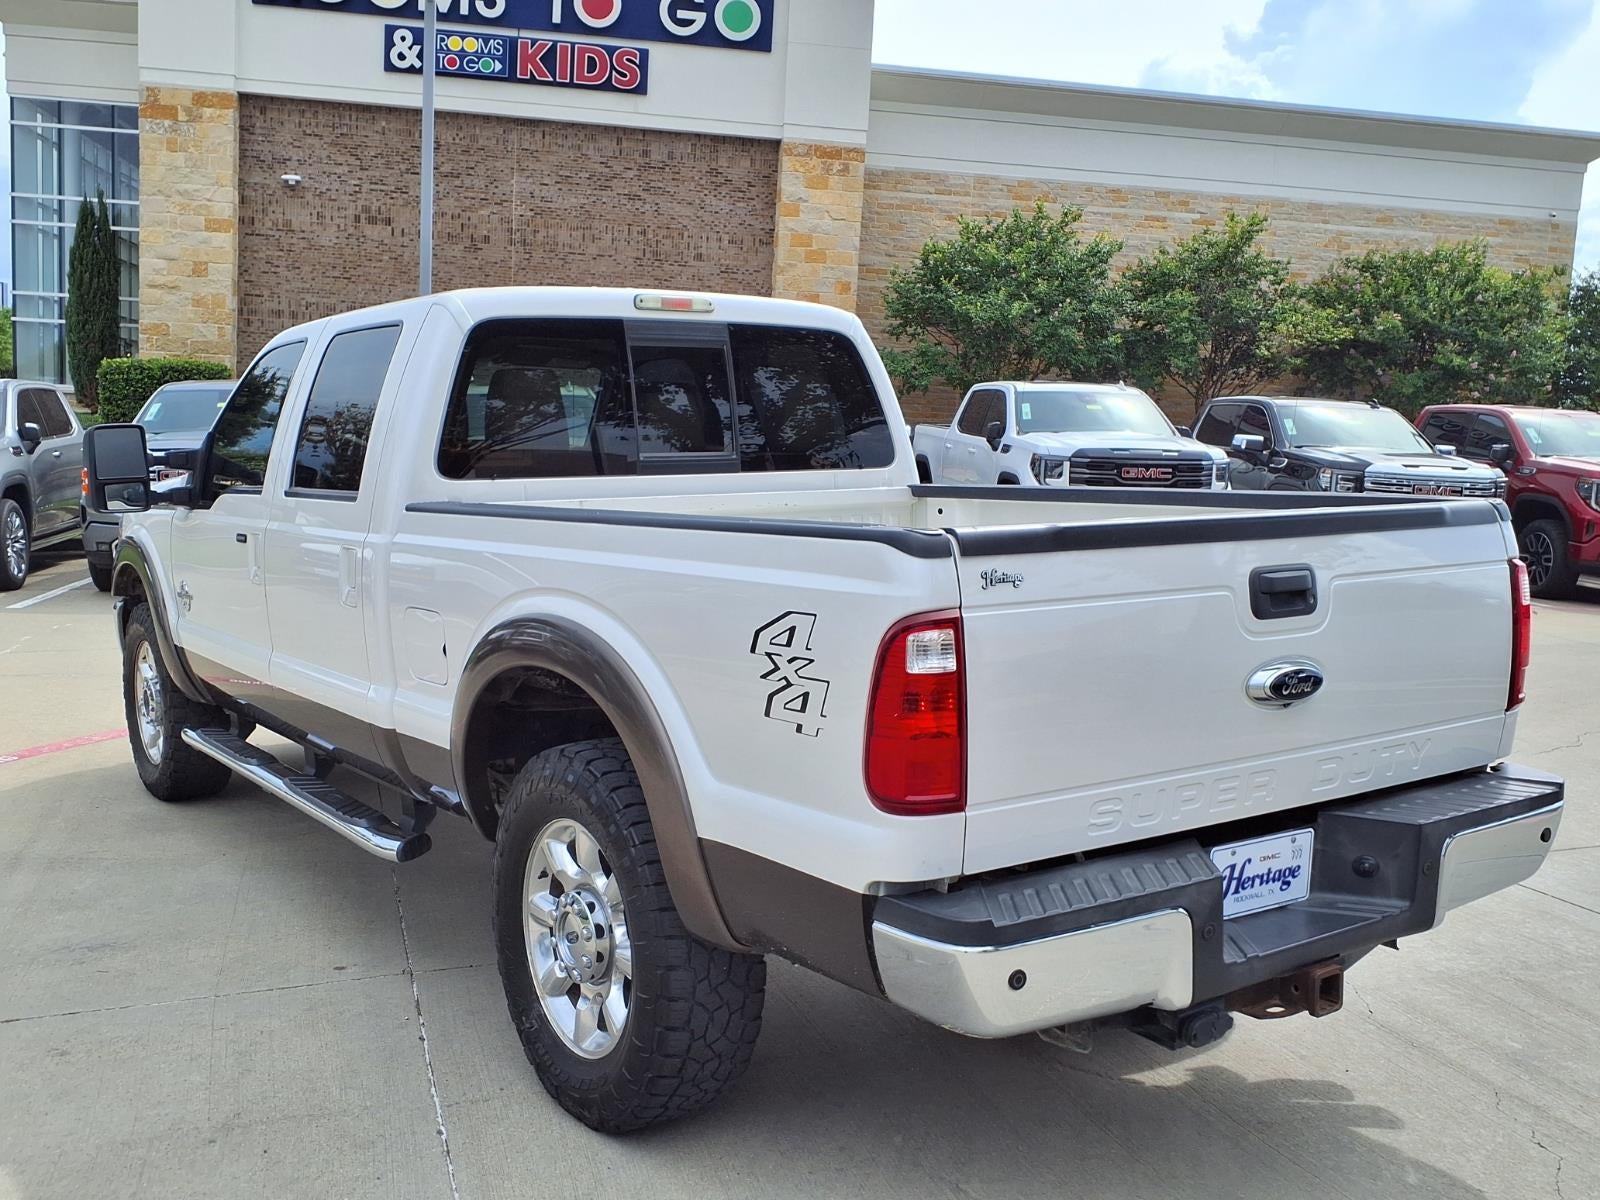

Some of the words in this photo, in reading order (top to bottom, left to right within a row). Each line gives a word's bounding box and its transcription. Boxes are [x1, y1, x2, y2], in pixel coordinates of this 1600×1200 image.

[659, 0, 762, 42] GO
[389, 28, 422, 69] &
[437, 34, 503, 55] ROOMS
[437, 53, 460, 70] TO
[463, 56, 495, 73] GO
[517, 39, 641, 90] KIDS
[1121, 467, 1173, 479] GMC
[1415, 485, 1462, 497] GMC
[980, 568, 1024, 590] Heritage
[1282, 672, 1314, 695] Ford
[1087, 768, 1278, 836] SUPER
[1312, 738, 1432, 791] DUTY
[1221, 857, 1301, 900] Heritage
